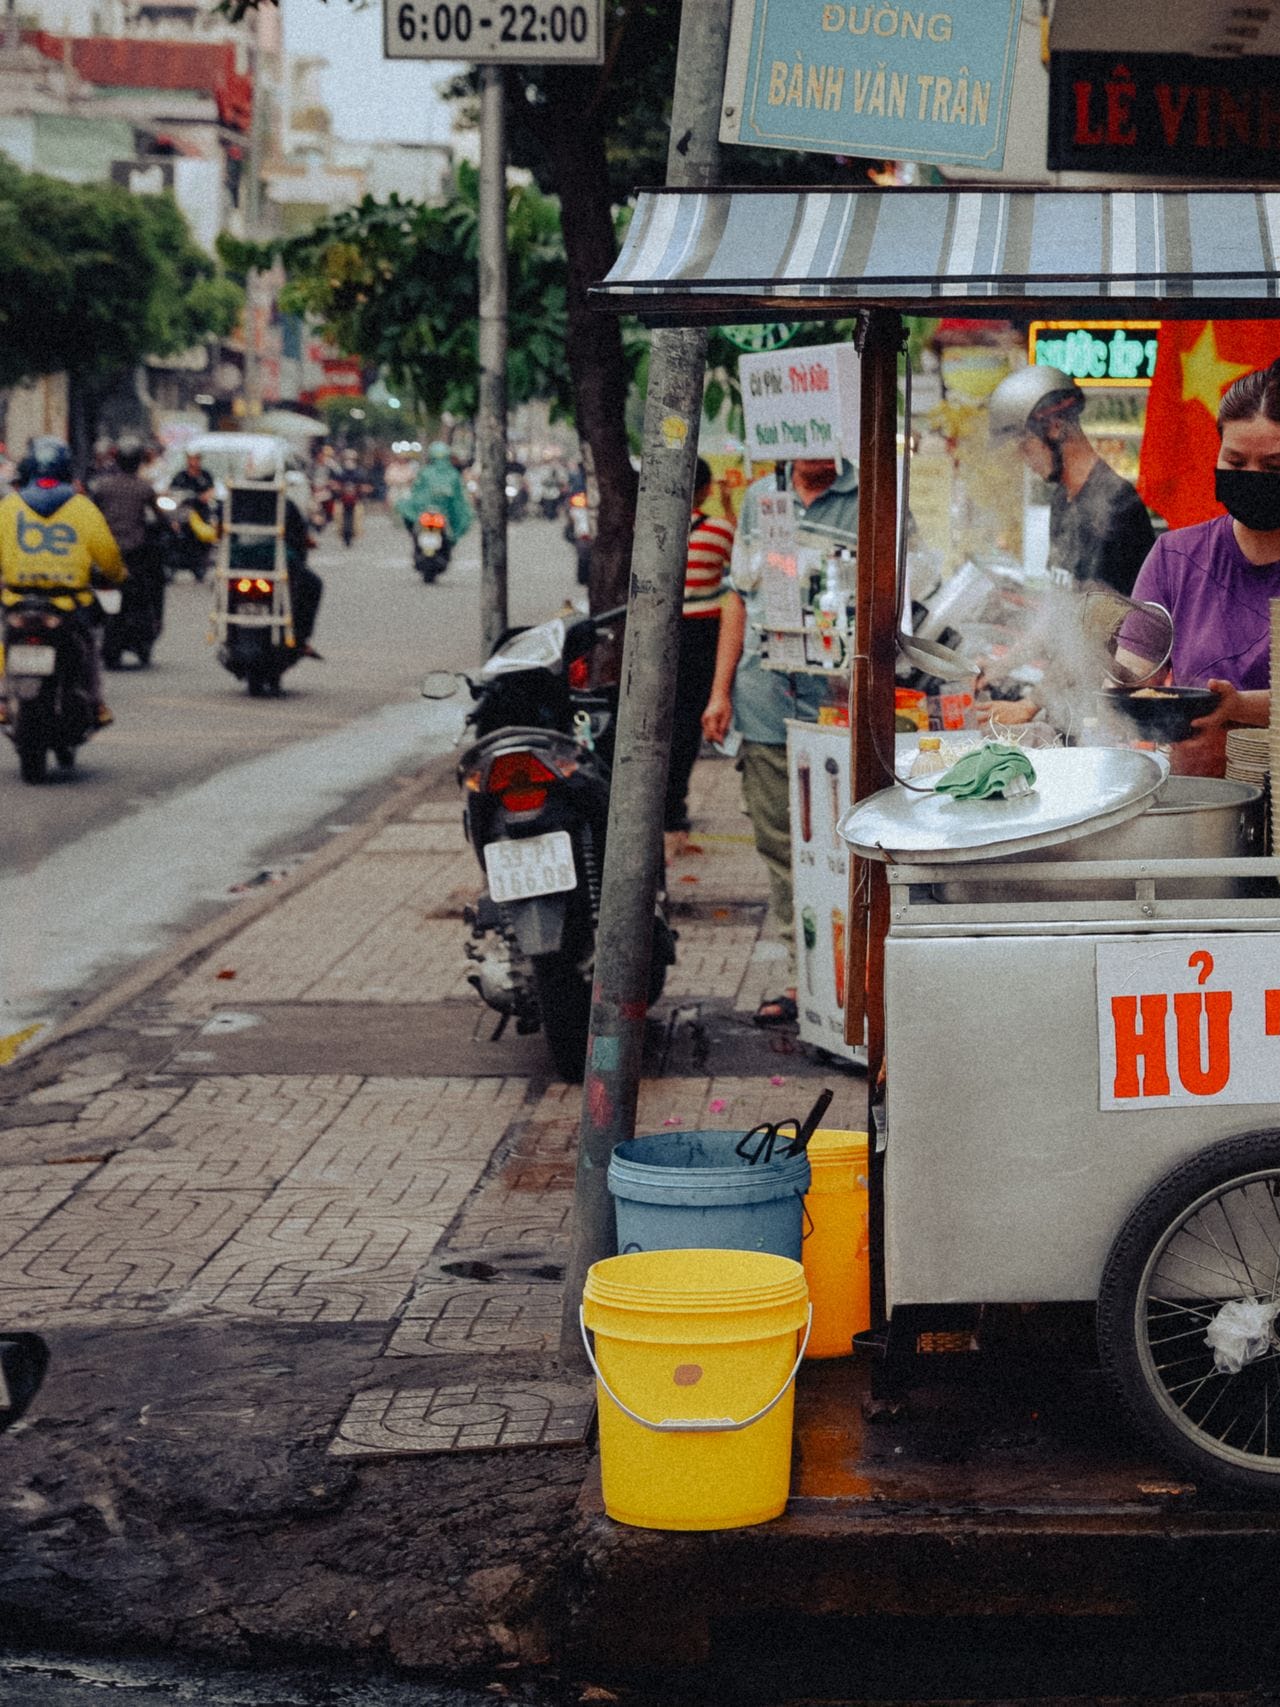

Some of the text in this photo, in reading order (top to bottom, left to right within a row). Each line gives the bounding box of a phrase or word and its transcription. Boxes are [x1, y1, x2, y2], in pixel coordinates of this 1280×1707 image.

[821, 3, 953, 42] ĐƯỜNG
[767, 50, 991, 126] BÀNH VĂN TRÂN
[1073, 63, 1137, 146] LÊ
[17, 510, 77, 555] be
[1111, 949, 1232, 1099] HỦ
